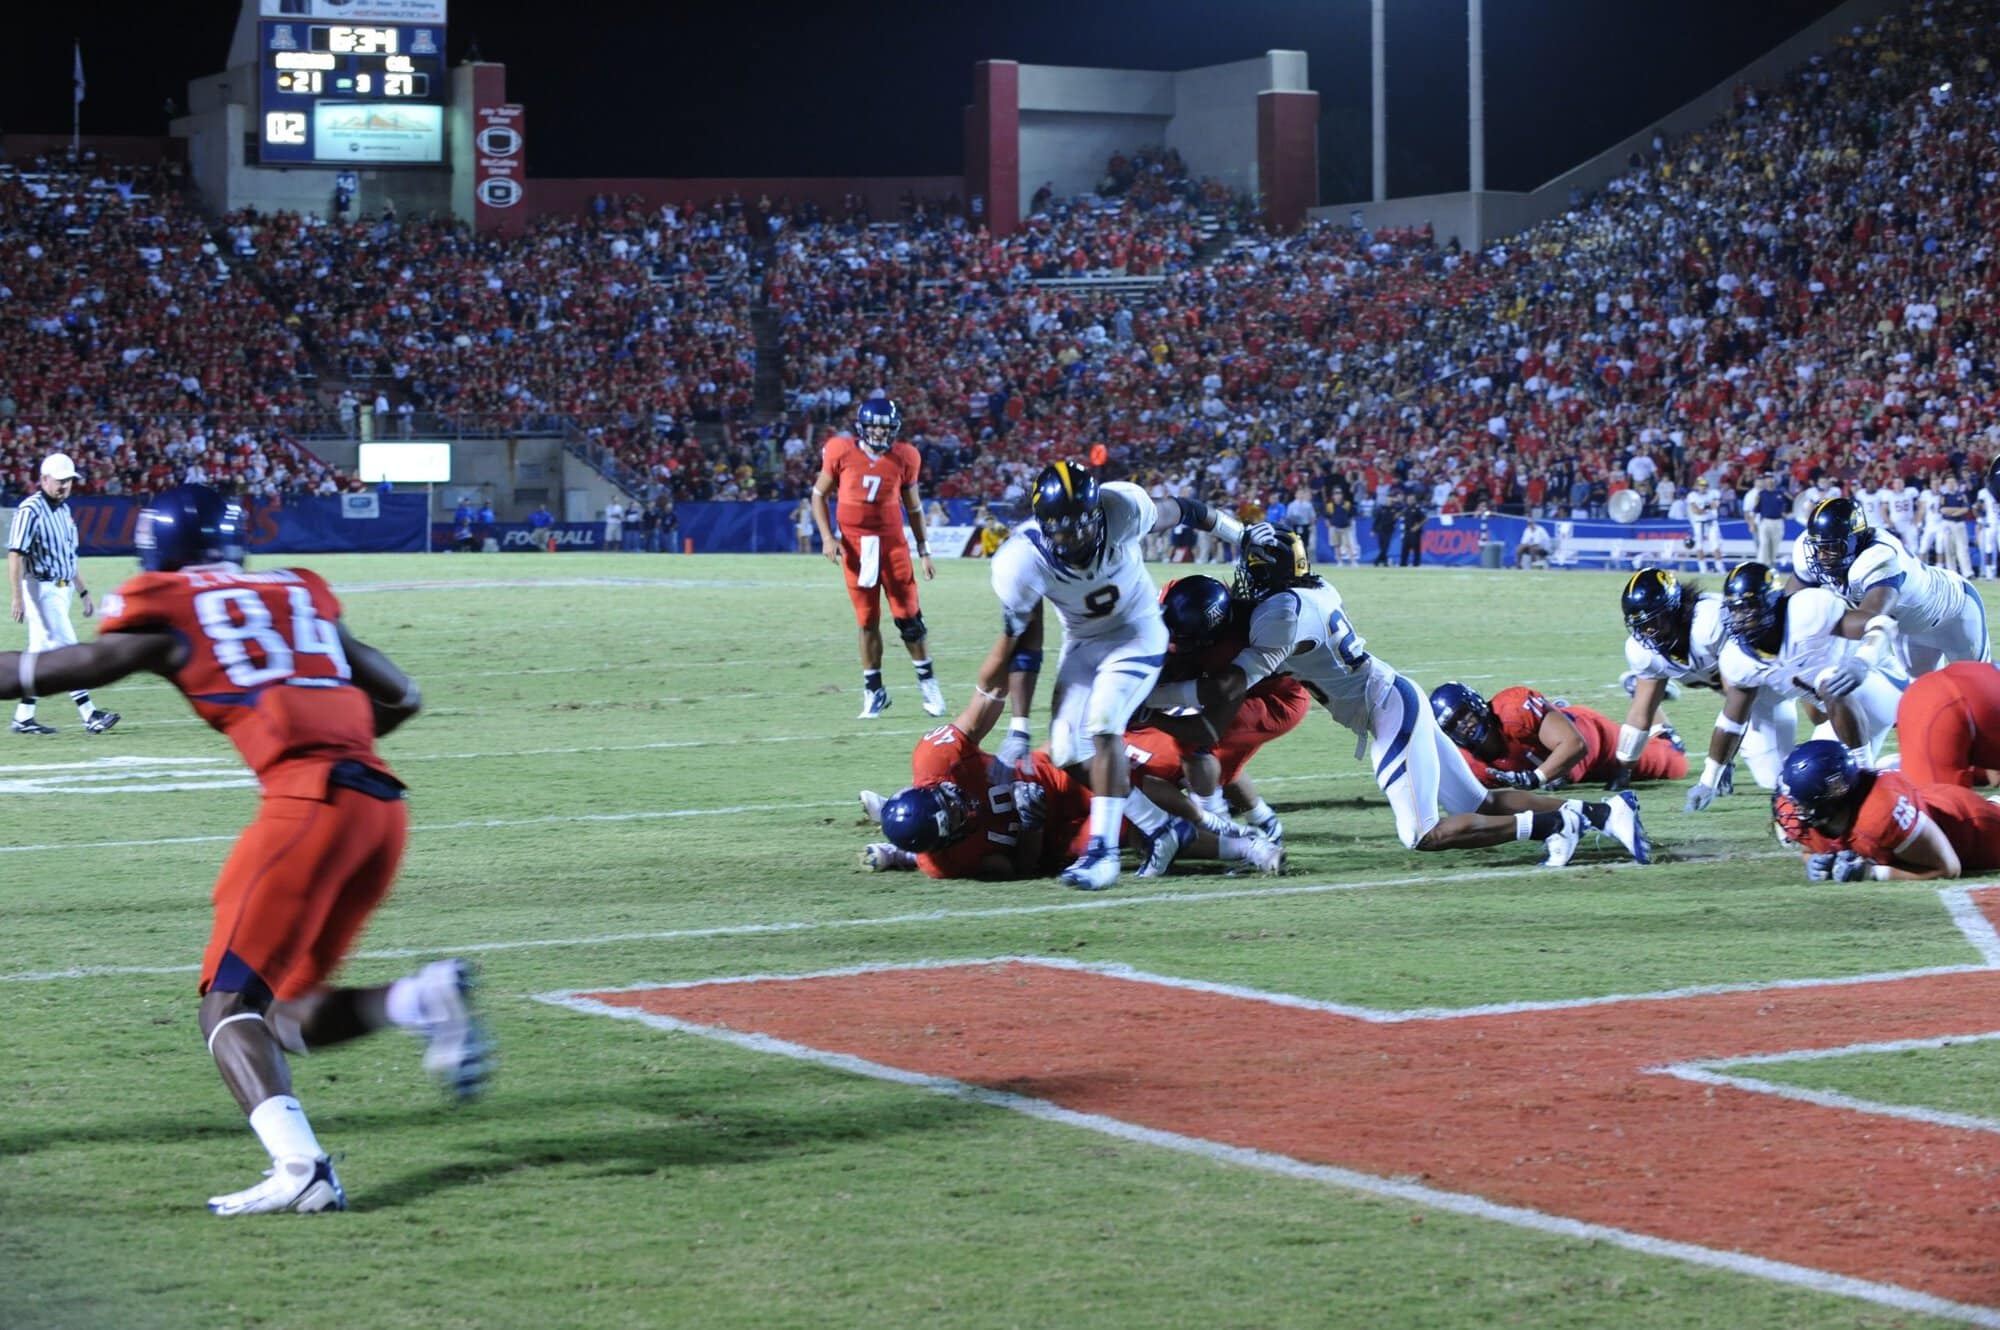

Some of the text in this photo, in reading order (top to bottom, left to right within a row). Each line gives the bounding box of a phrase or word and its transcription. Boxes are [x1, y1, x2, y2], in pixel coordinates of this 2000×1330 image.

[293, 71, 322, 92] 21
[862, 475, 881, 502] 7
[1084, 584, 1120, 618] 9
[194, 586, 351, 687] 84
